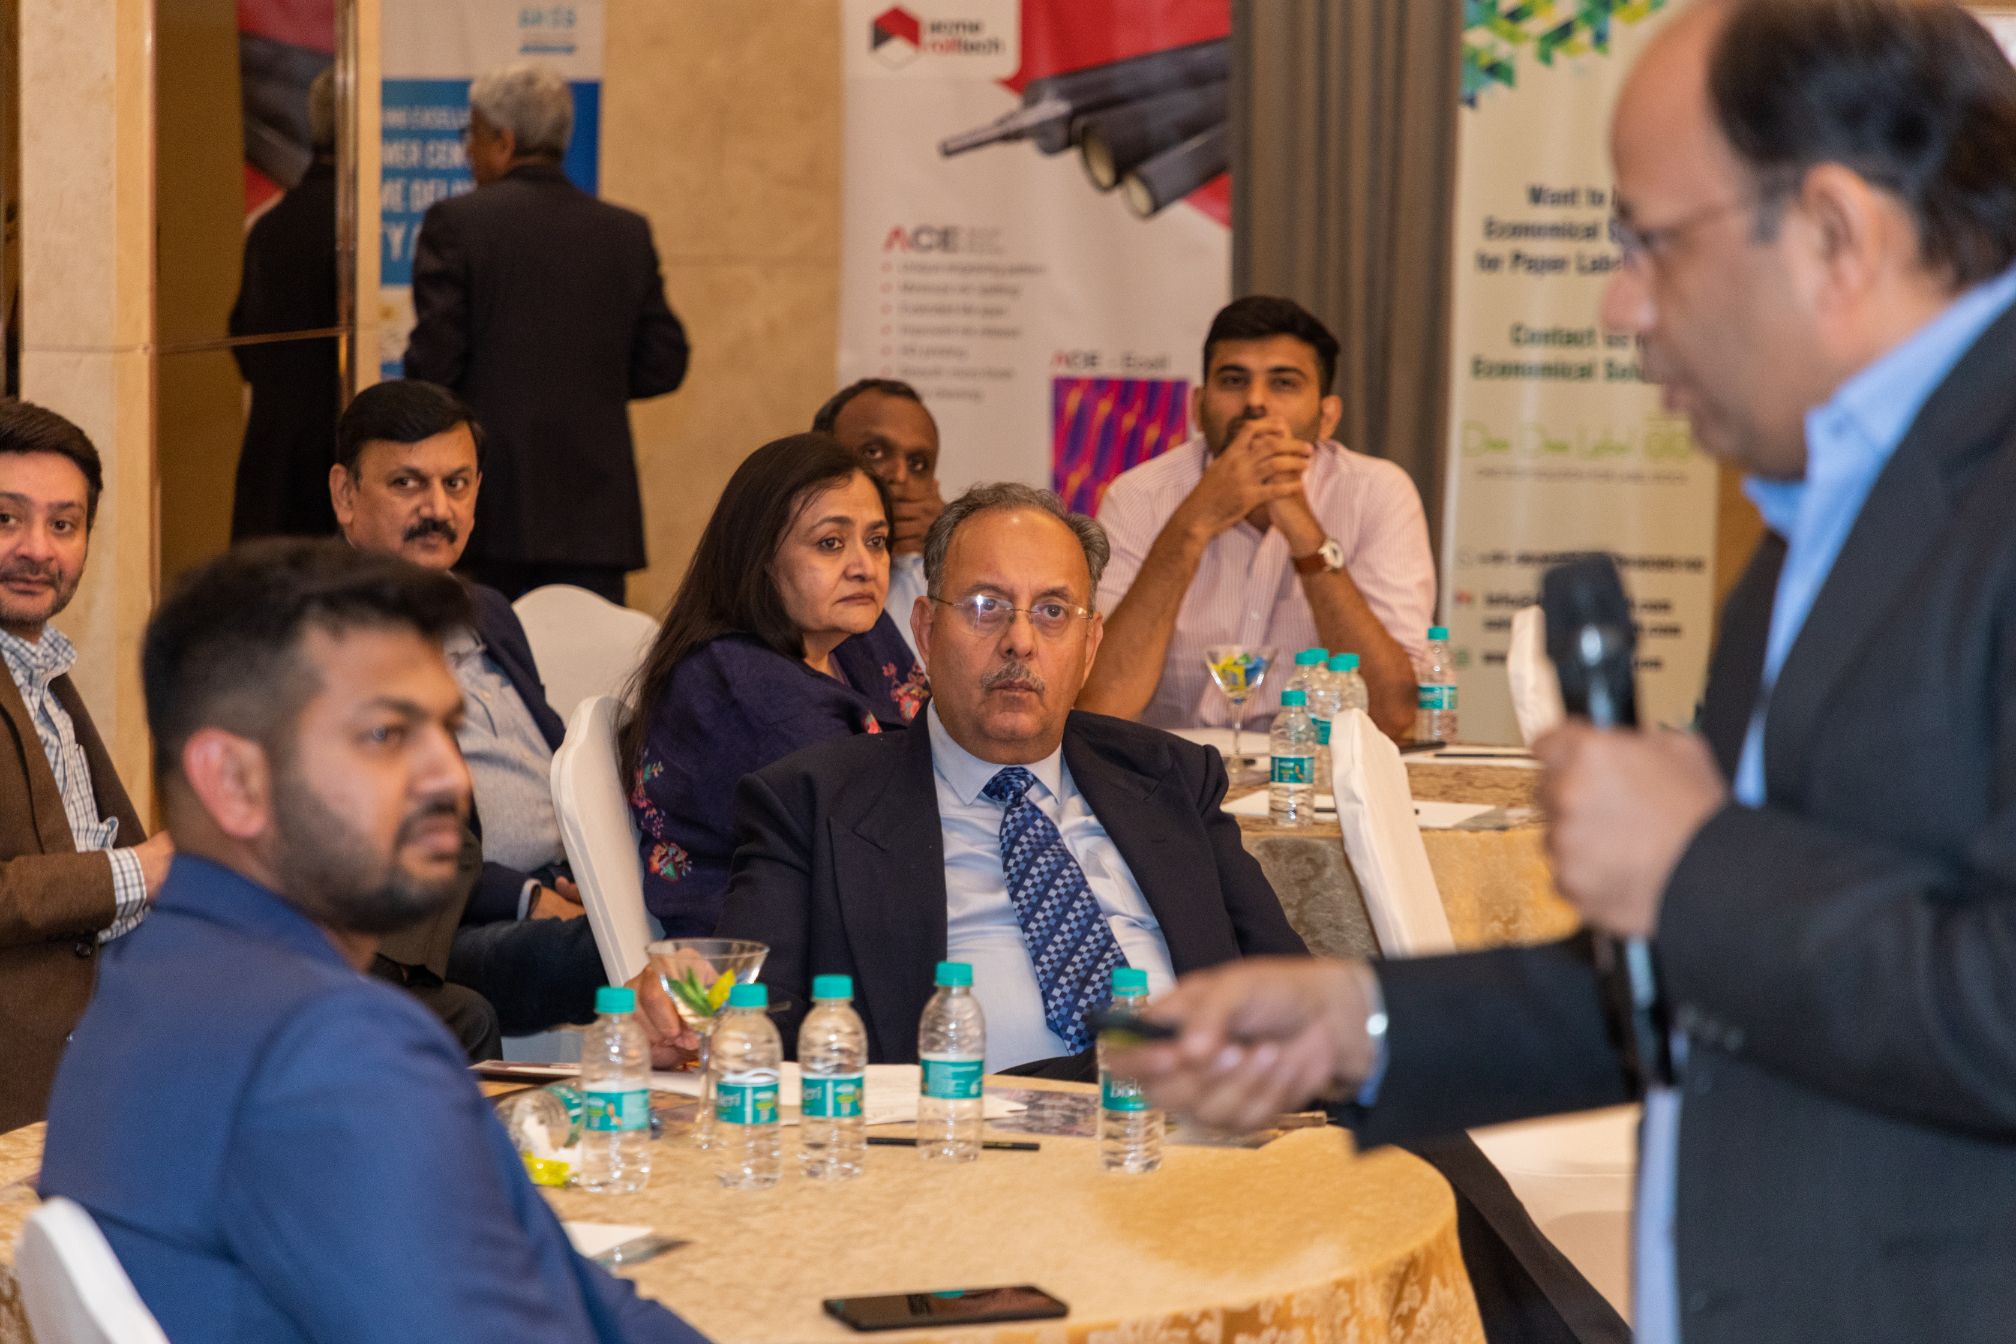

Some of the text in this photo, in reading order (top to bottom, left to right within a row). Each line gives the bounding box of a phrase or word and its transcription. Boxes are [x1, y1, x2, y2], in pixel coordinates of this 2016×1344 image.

[1528, 185, 1576, 207] Want
[1484, 219, 1600, 240] Economical
[1511, 324, 1595, 346] Contact
[1472, 357, 1593, 380] Economical
